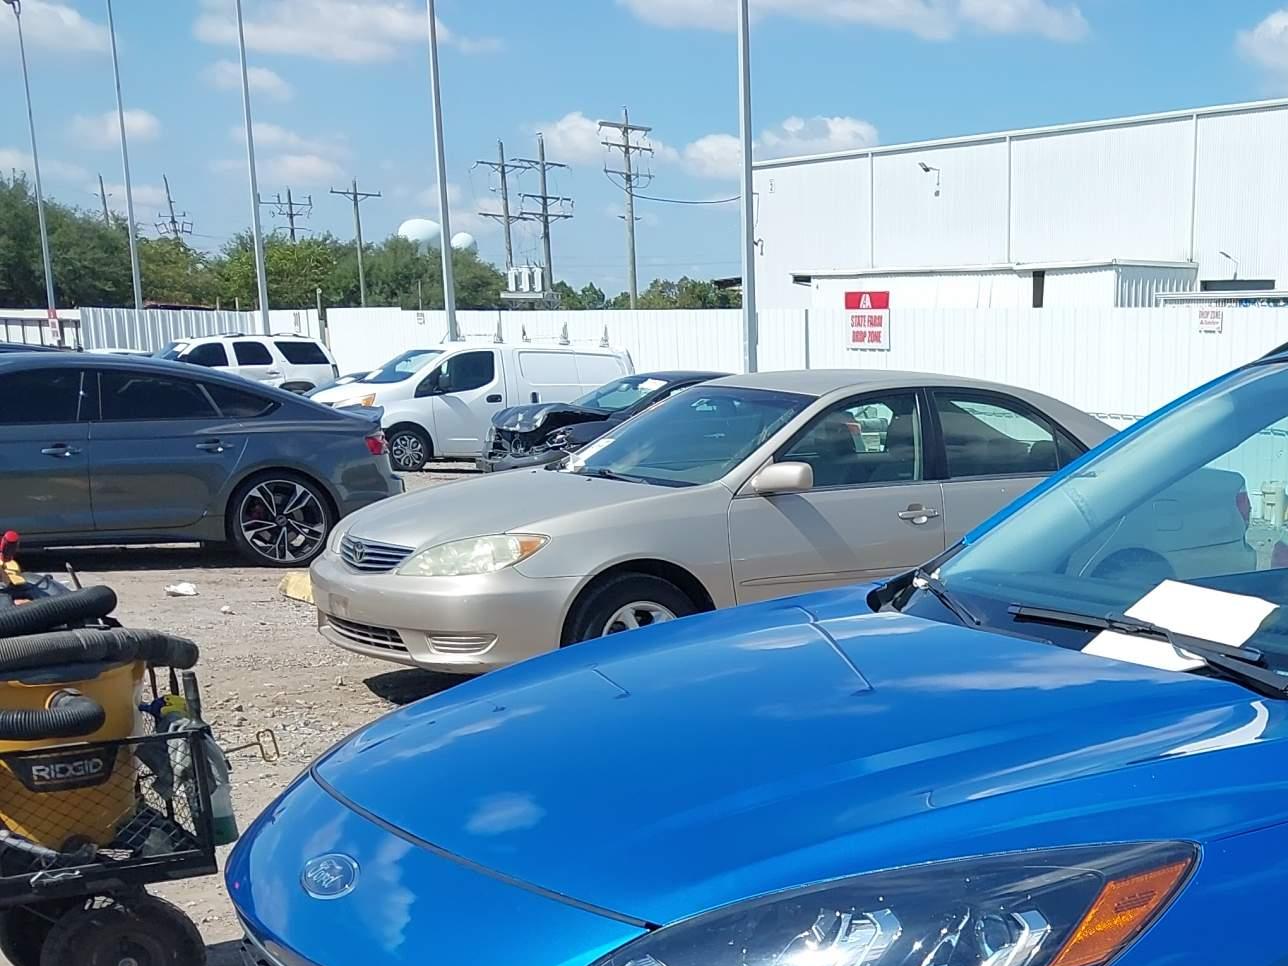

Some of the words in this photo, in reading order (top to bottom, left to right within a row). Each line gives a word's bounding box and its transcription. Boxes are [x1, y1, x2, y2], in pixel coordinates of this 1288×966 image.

[851, 315, 866, 328] STATE
[867, 315, 883, 328] FARM
[852, 330, 867, 343] DROP
[868, 330, 882, 344] ZONE
[31, 758, 104, 781] RIDGID
